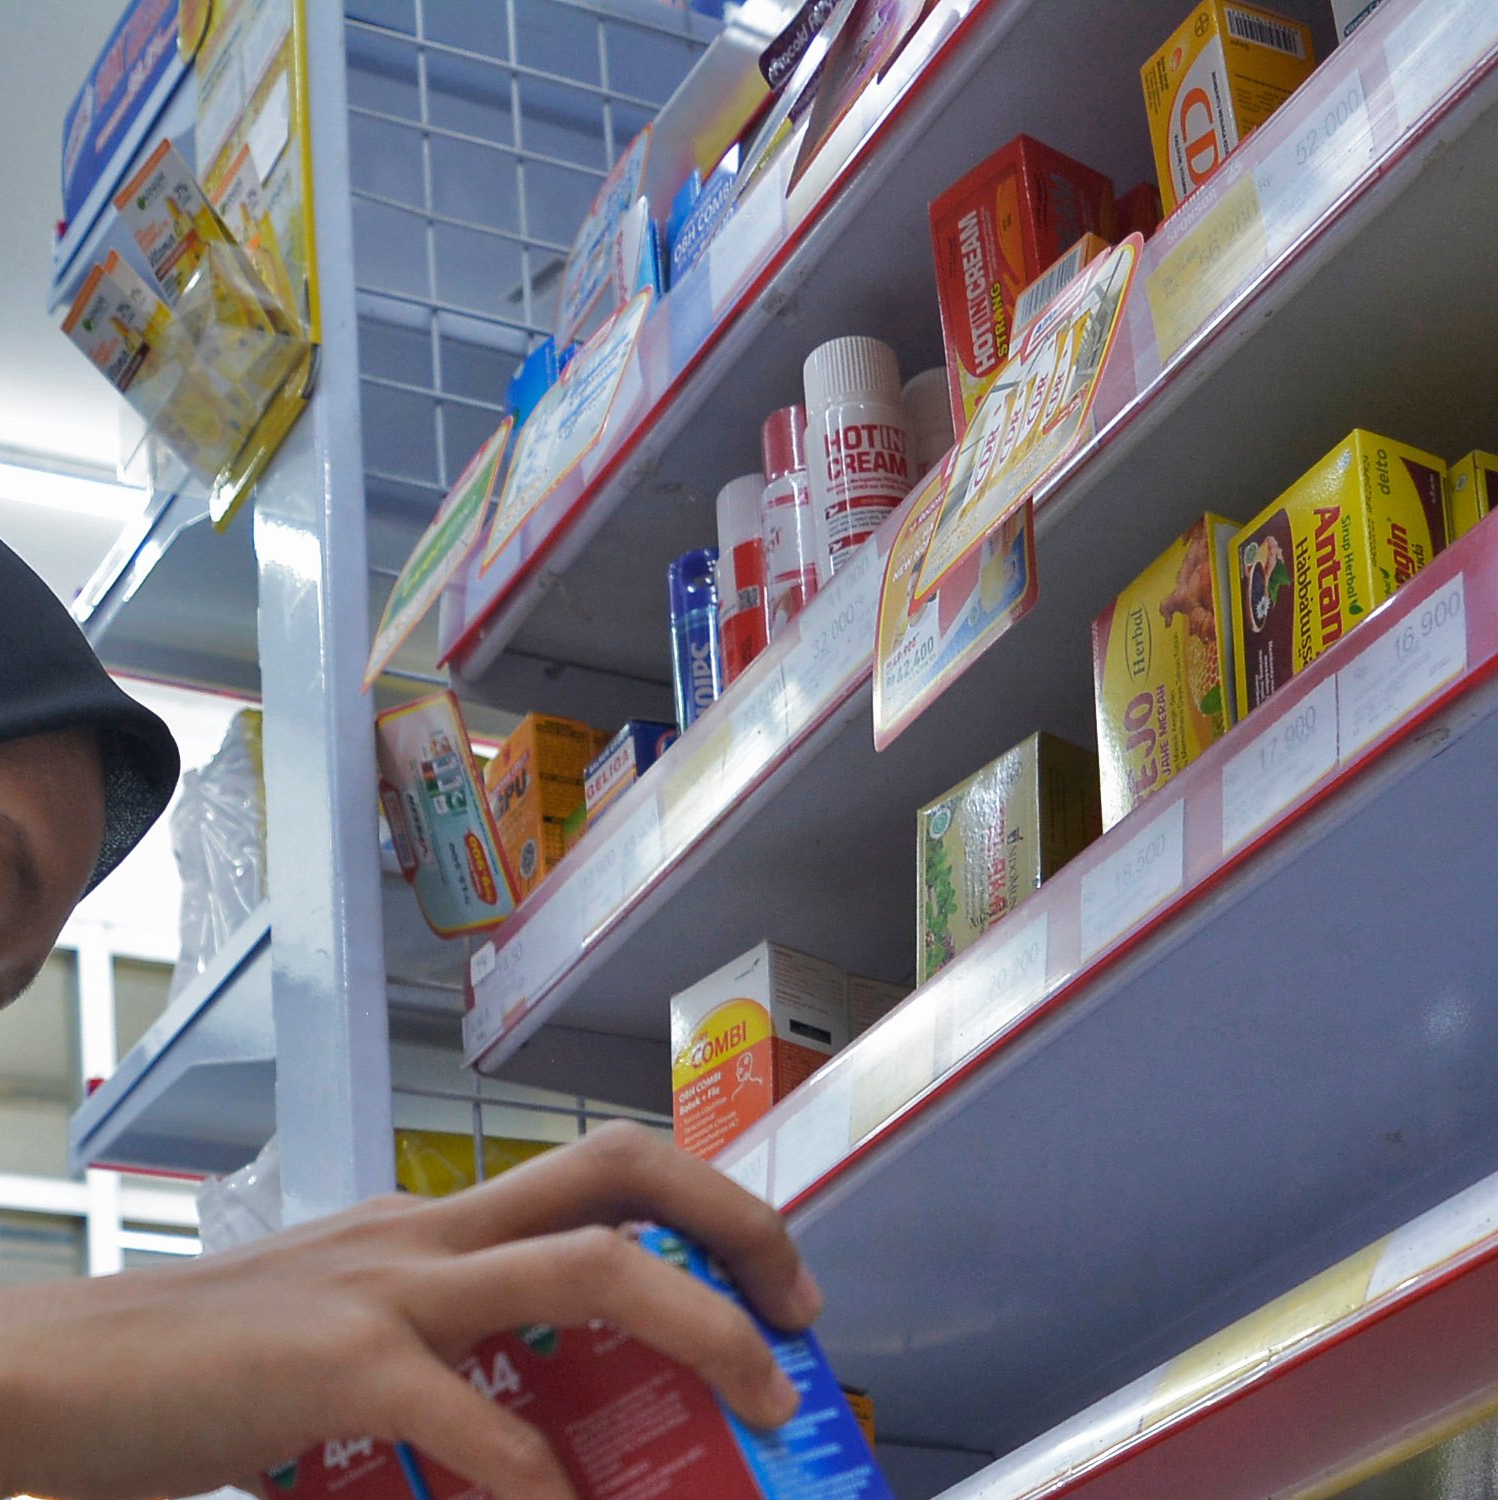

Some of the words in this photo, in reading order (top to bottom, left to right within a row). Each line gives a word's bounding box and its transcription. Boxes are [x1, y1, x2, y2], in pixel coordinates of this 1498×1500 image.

[1179, 87, 1221, 185] CD
[974, 423, 1000, 491] CDR
[1002, 409, 1022, 462] CDR
[1027, 373, 1049, 427] CDR
[828, 451, 909, 482] CREAM
[1342, 515, 1352, 551] Sirup
[1314, 504, 1343, 648] Antan
[1344, 551, 1358, 601] Herbal
[1130, 608, 1147, 678] Herbal
[1156, 684, 1170, 738] MERAH
[1123, 690, 1161, 800] EJO
[1158, 737, 1172, 778] JAHE
[586, 746, 631, 801] GELIGA
[691, 1020, 748, 1069] COMBI
[695, 1071, 723, 1093] COMBI
